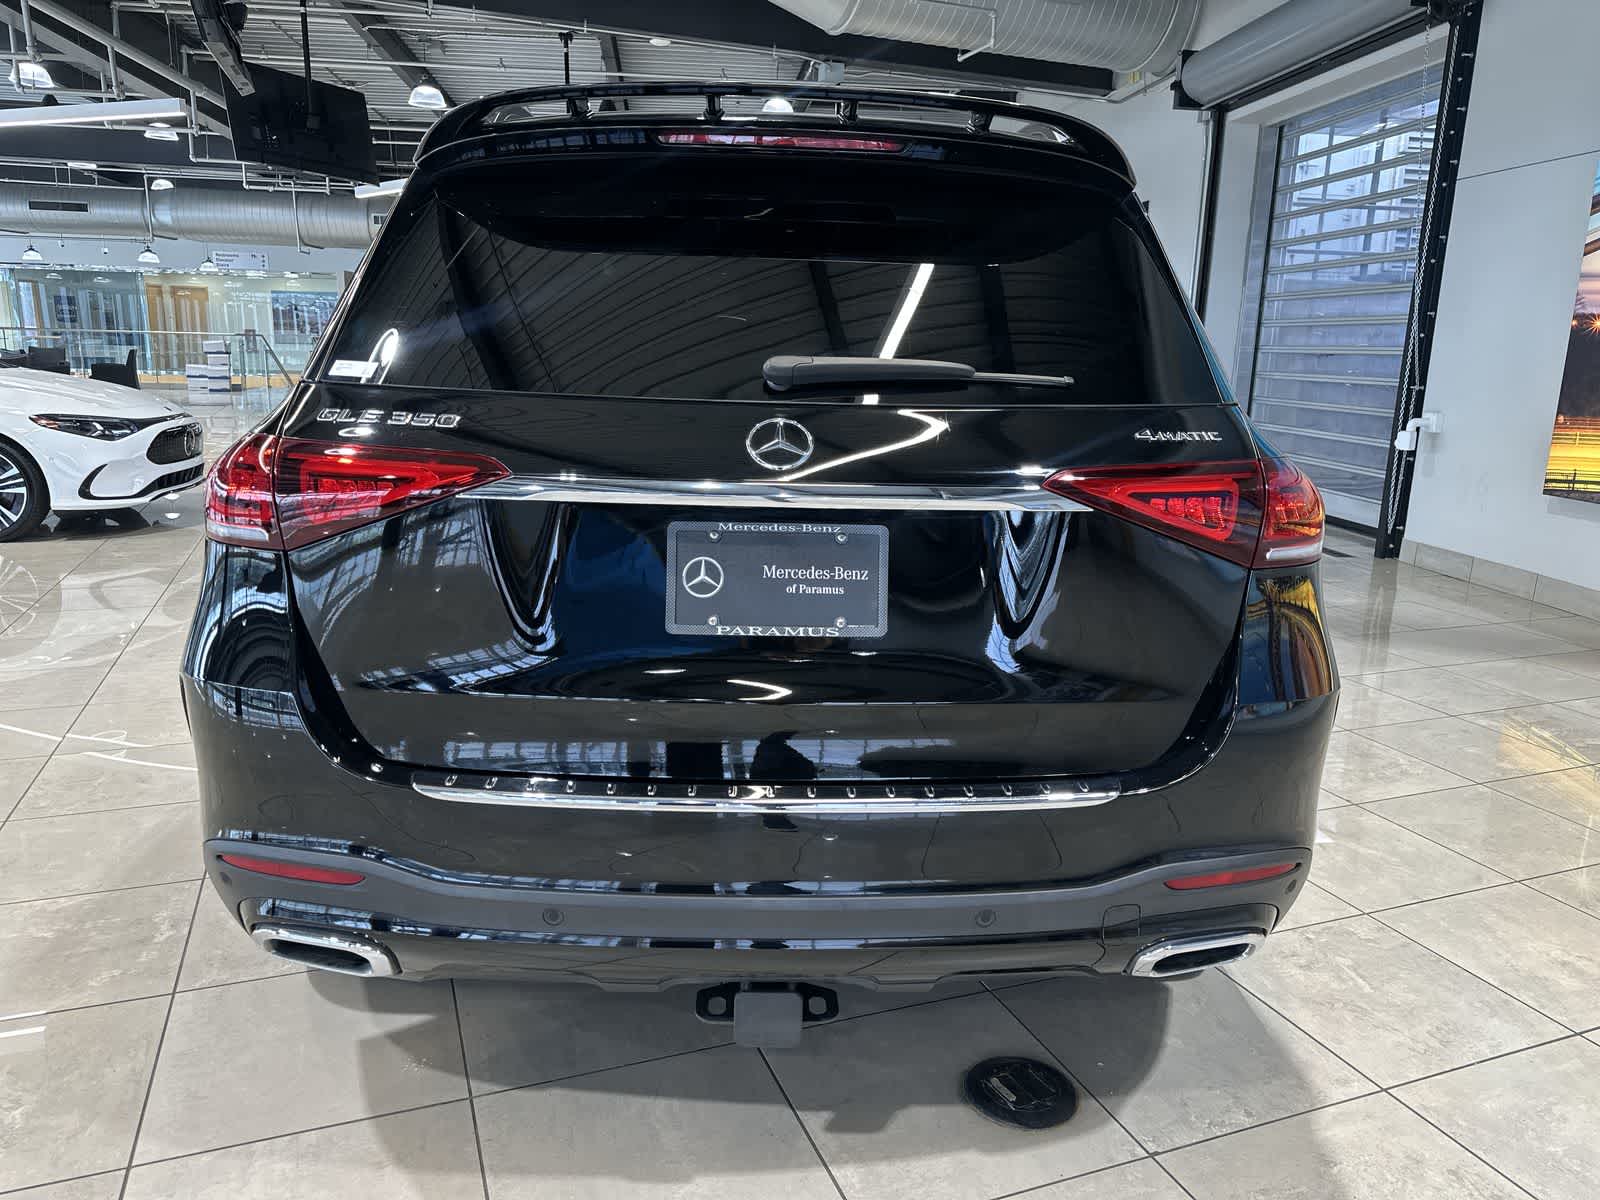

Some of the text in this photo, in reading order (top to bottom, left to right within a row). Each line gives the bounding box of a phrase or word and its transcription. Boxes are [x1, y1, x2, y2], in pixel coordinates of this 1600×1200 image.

[317, 407, 462, 428] GLE 350
[1134, 429, 1223, 441] 4MATIC
[718, 522, 842, 533] Mercedes-Benz
[762, 565, 869, 581] Mercedes-Benz
[786, 584, 845, 595] of Paramus
[715, 625, 840, 637] PARAMUS
